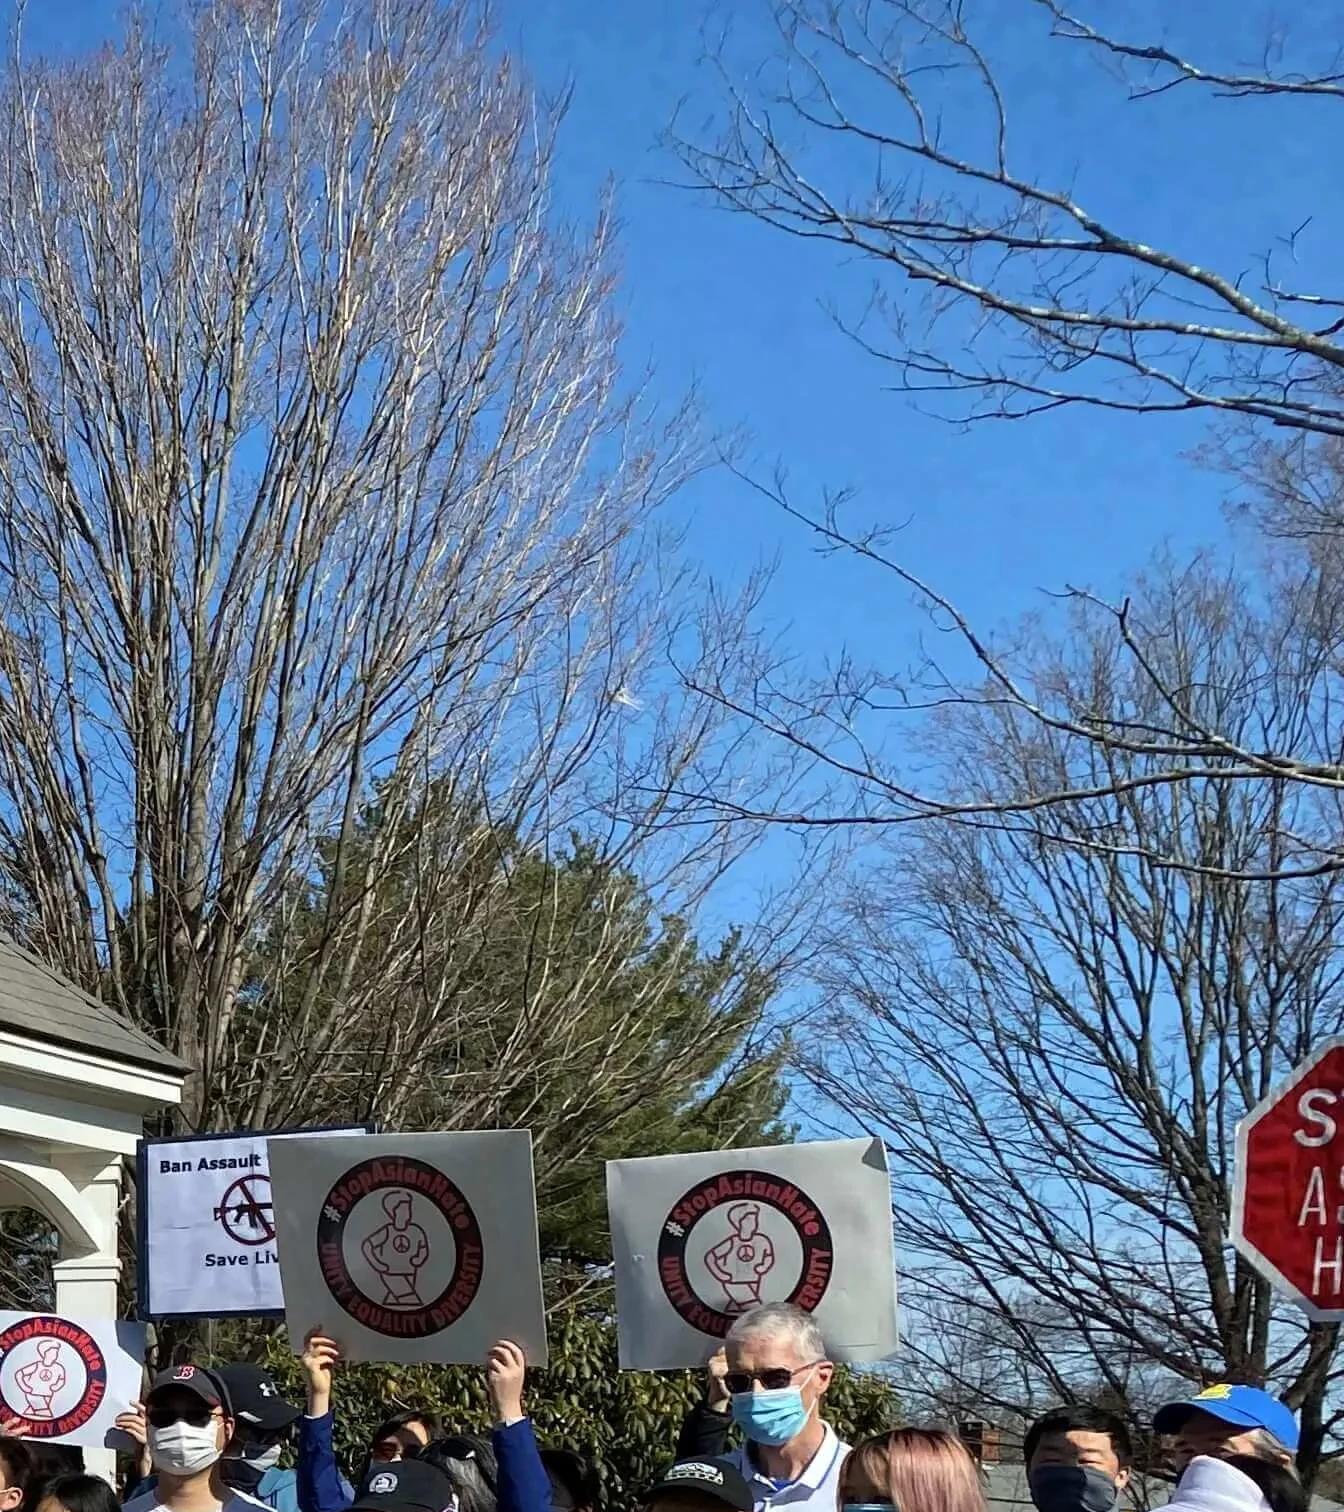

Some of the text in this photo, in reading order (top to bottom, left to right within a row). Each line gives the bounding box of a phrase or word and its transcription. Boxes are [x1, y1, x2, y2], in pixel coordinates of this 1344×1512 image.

[1293, 1088, 1344, 1147] S
[160, 1154, 262, 1173] Ban Assault
[323, 1159, 470, 1229] #StopAsianHate
[665, 1173, 820, 1238] #StopAsianHate
[205, 1250, 279, 1267] Save Liv
[663, 1255, 690, 1308] UNITY
[320, 1242, 482, 1333] UNITY EQUALITY DIVERSITY
[57, 1378, 105, 1433] DIVERSITY
